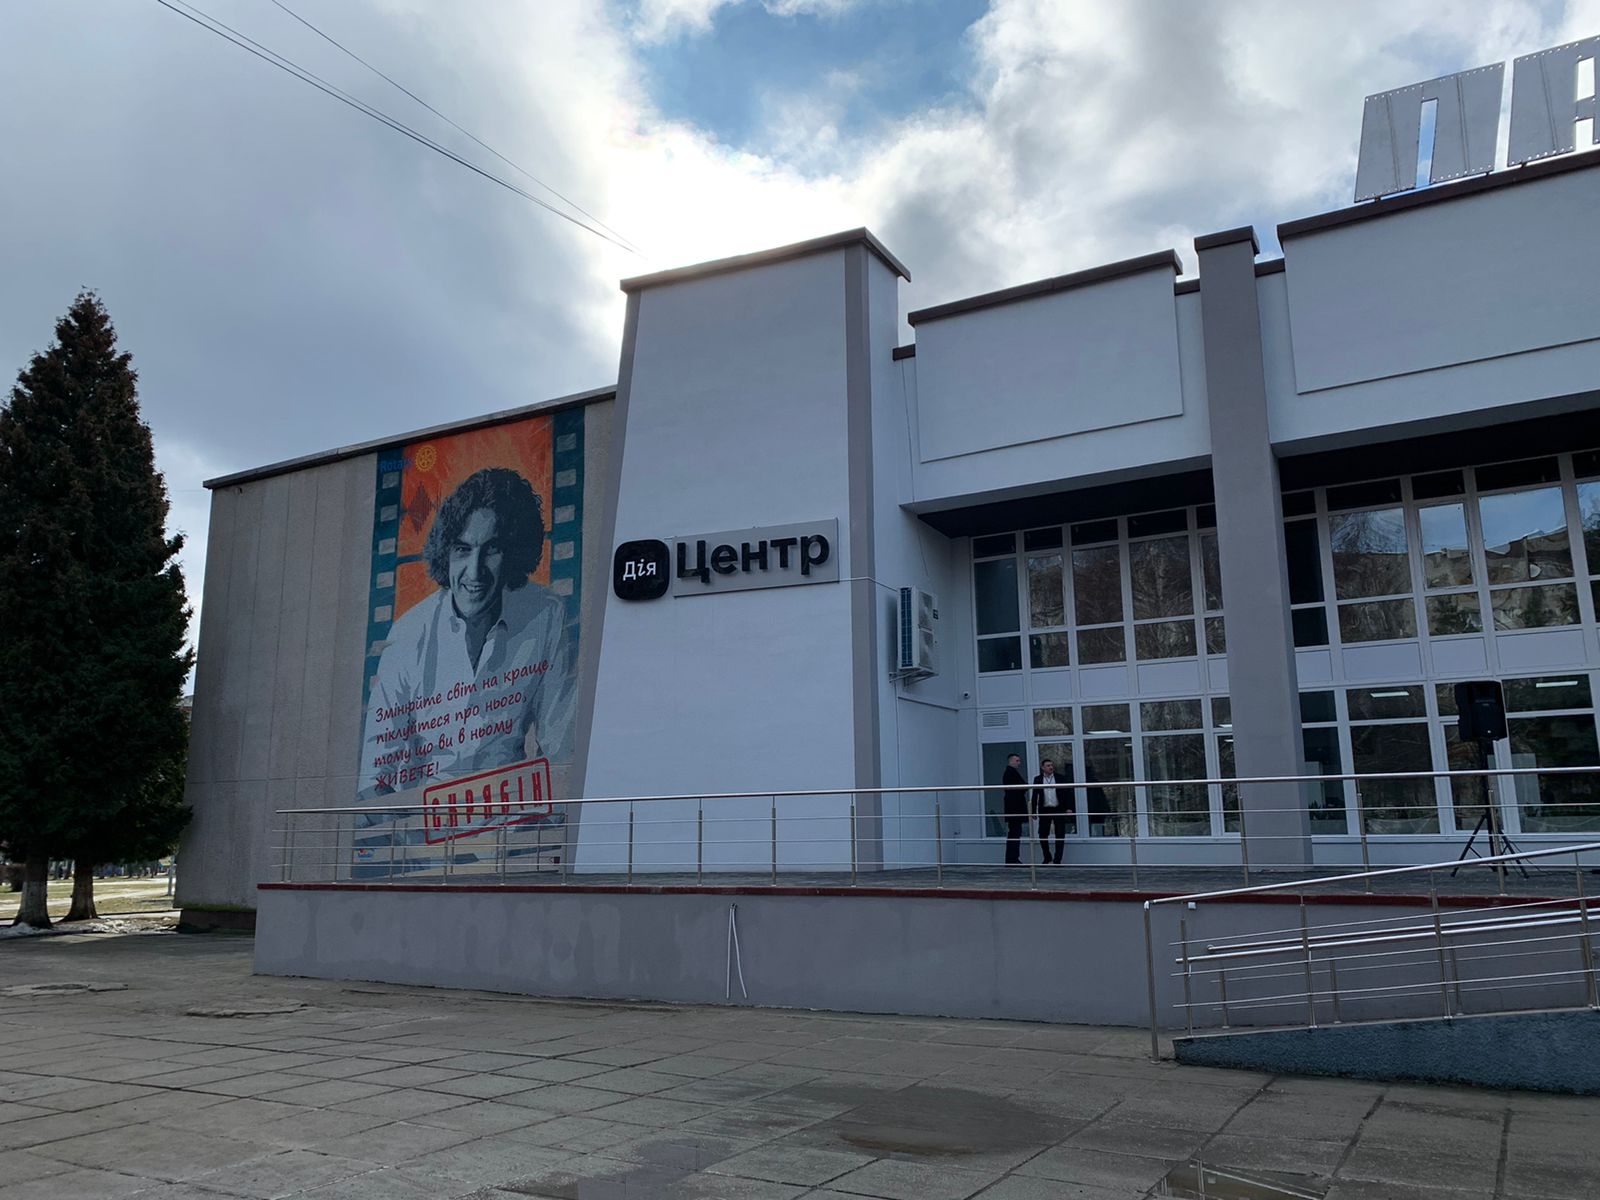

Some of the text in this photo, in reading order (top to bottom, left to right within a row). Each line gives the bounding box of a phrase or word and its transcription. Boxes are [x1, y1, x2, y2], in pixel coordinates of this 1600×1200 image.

[622, 534, 830, 584] Дія Центр
[375, 659, 554, 722] Змінюйте світ на краще,
[374, 718, 513, 767] тому що ви в ньому
[375, 715, 450, 744] піклуйтеся
[455, 704, 480, 723] про
[375, 761, 440, 791] ЖИВЕТЕ!
[432, 771, 542, 831] СКРЯБІН
